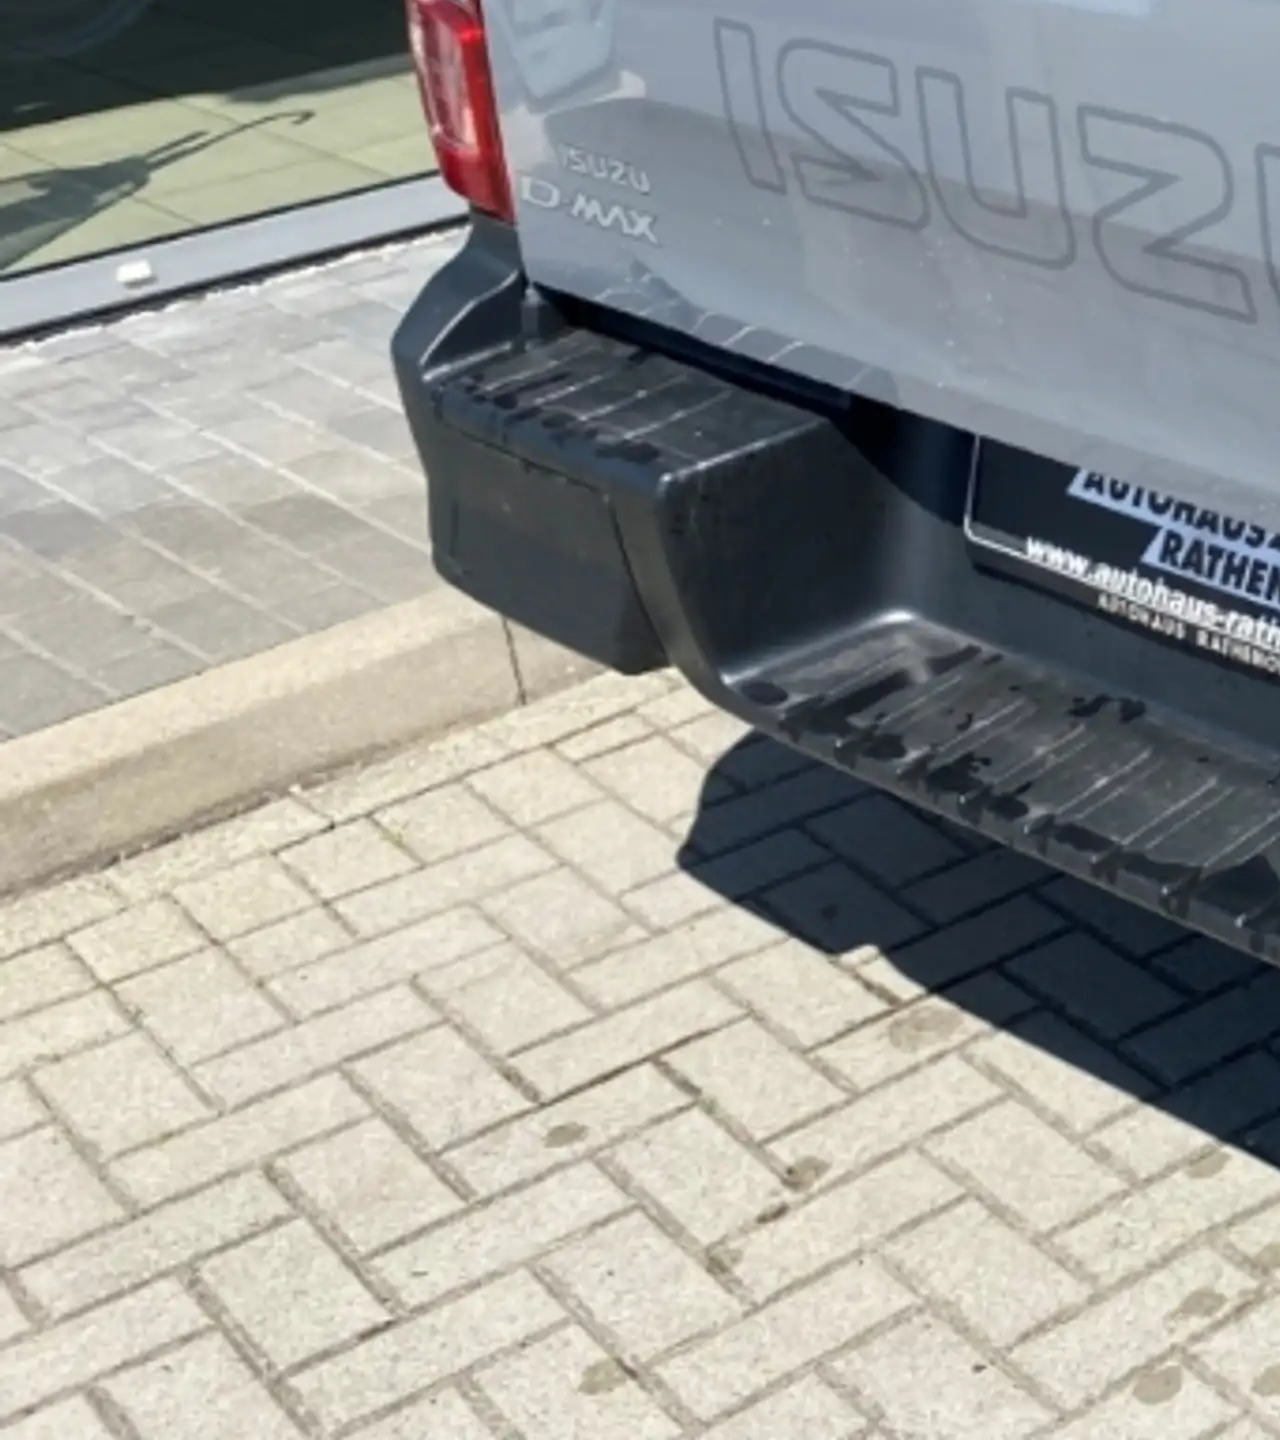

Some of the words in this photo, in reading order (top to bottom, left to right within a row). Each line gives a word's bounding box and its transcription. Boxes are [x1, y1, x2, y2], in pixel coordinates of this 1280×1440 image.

[562, 144, 651, 194] ISUZU
[520, 175, 660, 246] D-MAX
[1098, 593, 1187, 641] AUTOHAUS
